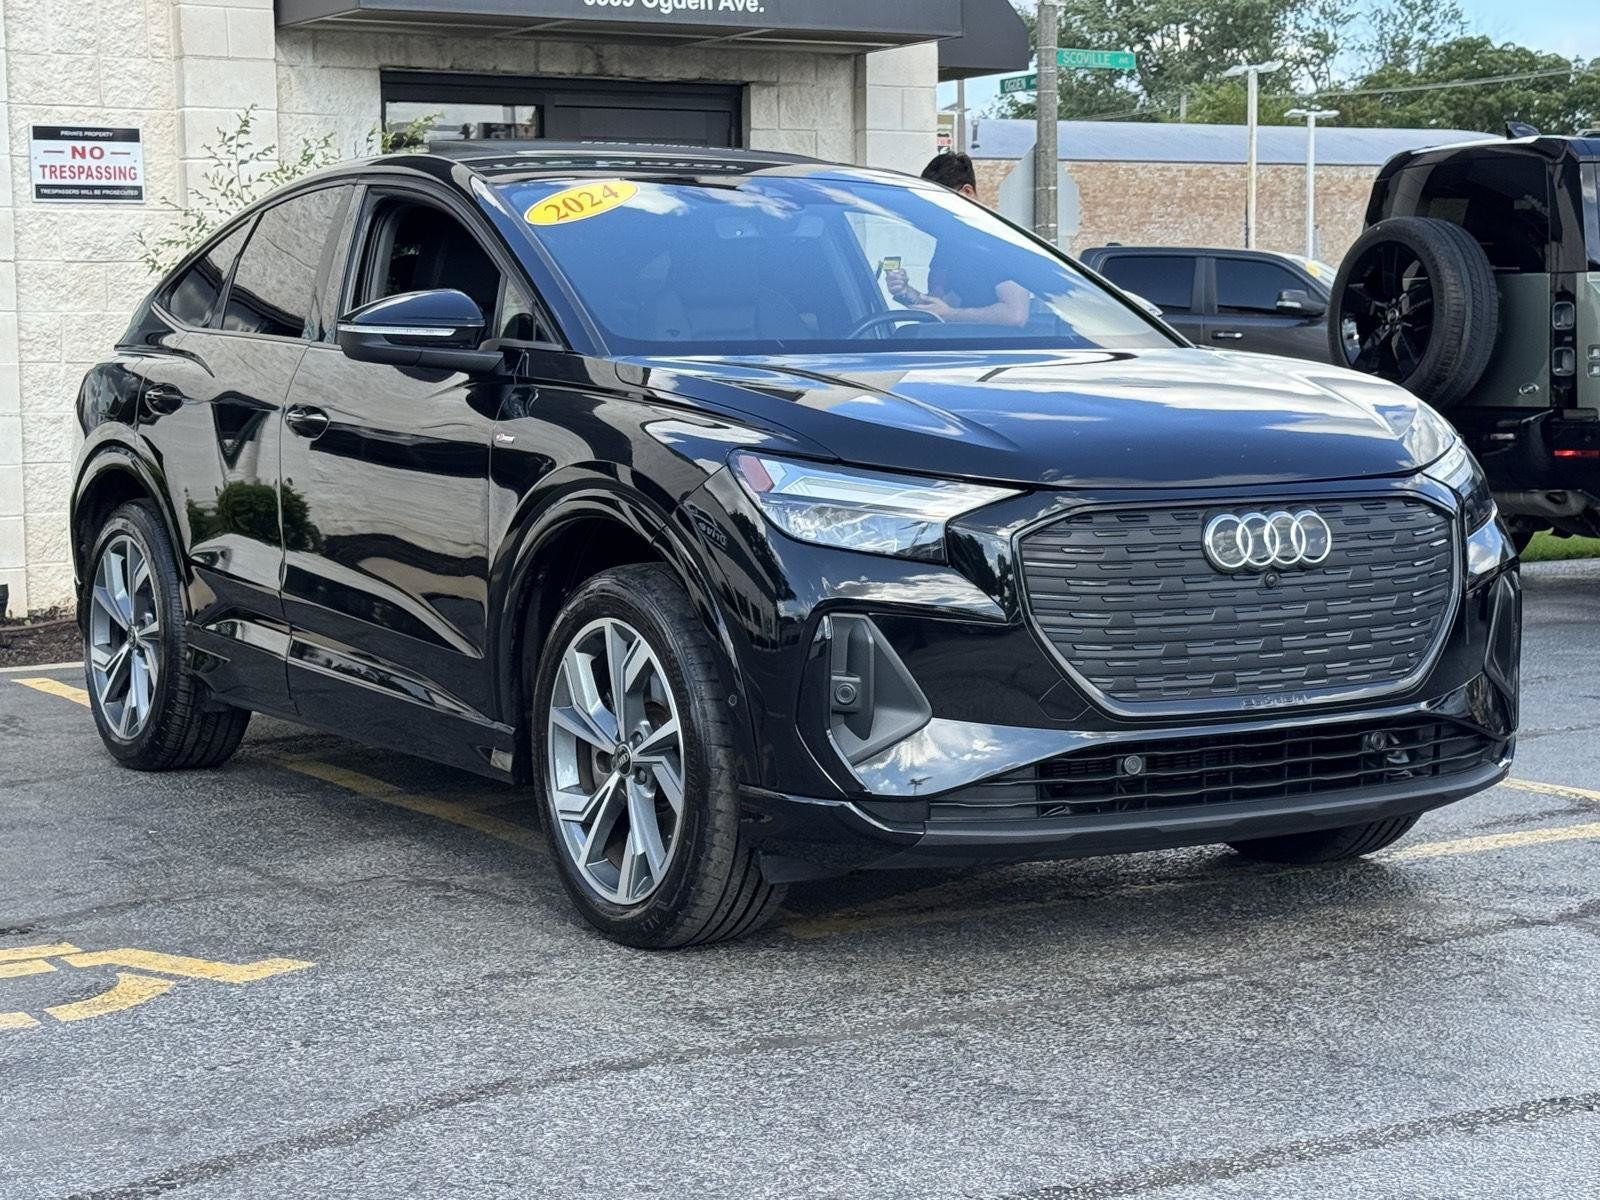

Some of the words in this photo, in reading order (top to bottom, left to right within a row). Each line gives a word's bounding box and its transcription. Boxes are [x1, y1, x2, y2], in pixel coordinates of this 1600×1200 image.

[1063, 51, 1111, 66] SCOVILLE
[71, 146, 105, 160] NO
[39, 164, 138, 181] TRESPASSING
[544, 184, 619, 221] 2024
